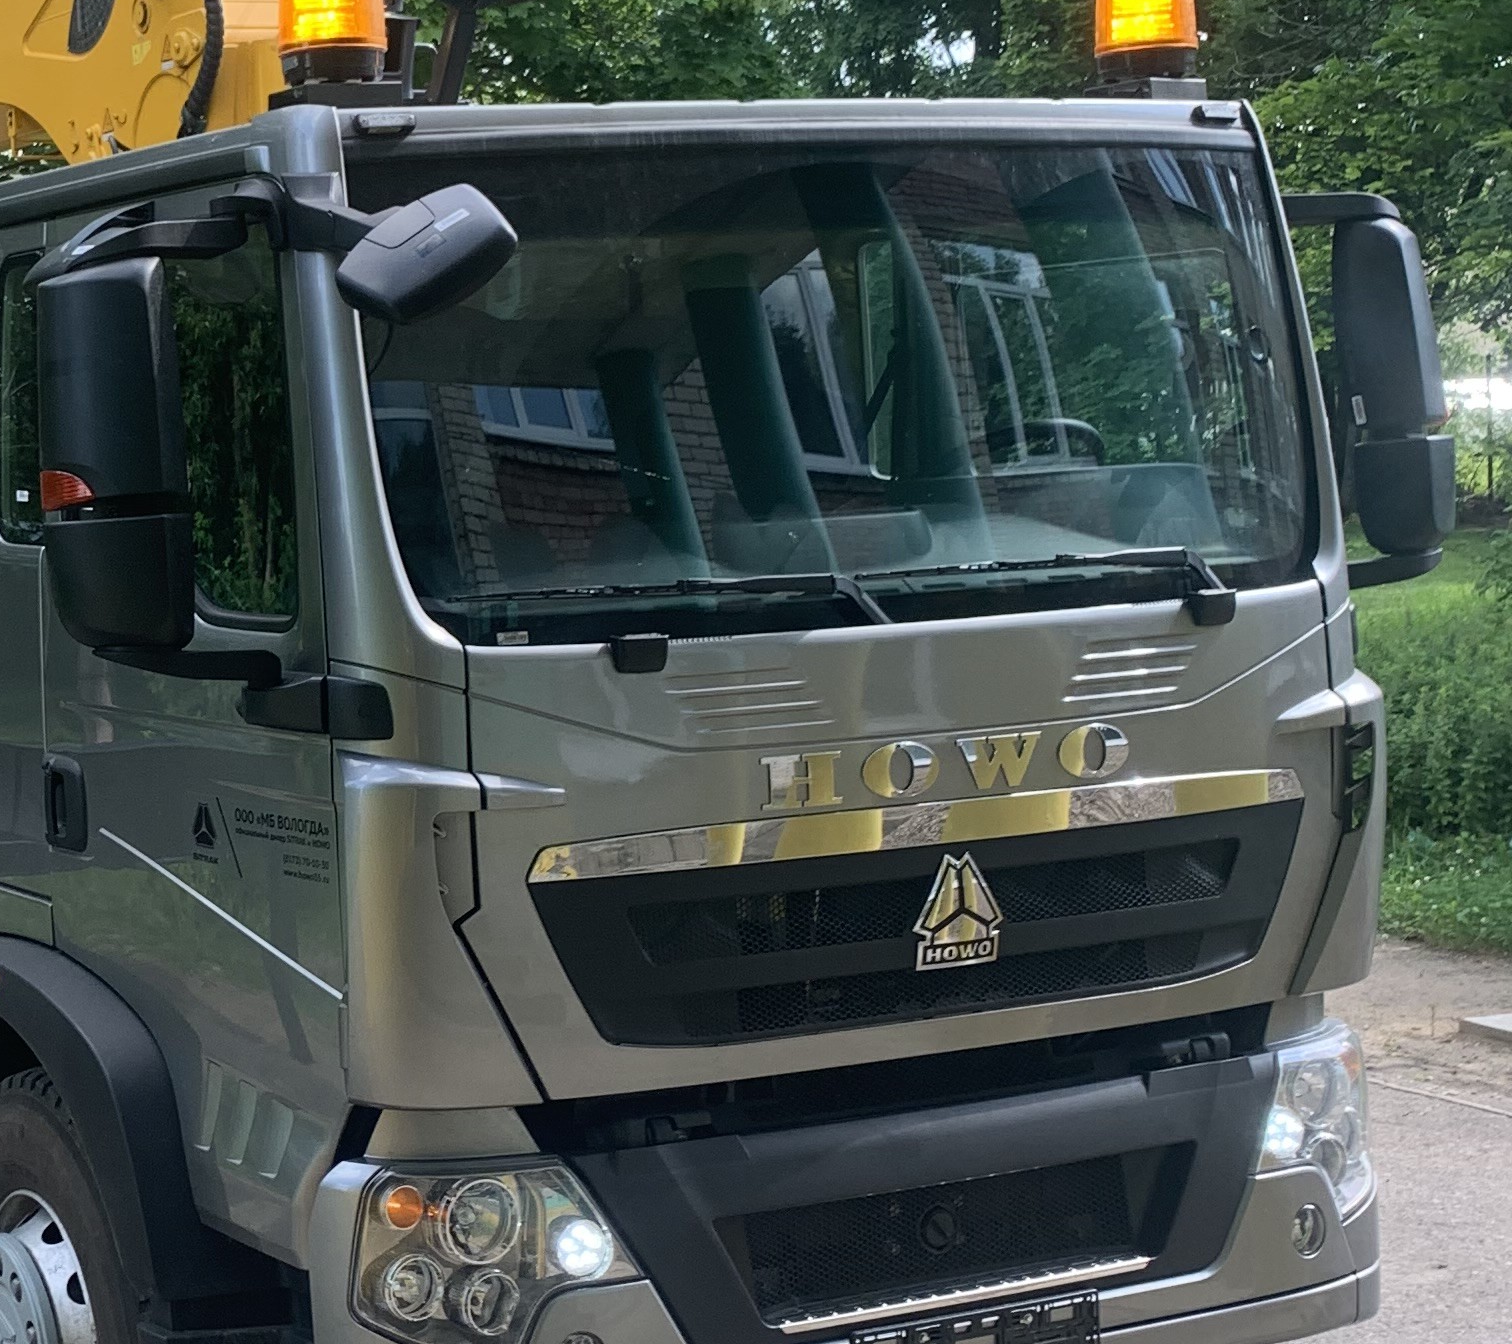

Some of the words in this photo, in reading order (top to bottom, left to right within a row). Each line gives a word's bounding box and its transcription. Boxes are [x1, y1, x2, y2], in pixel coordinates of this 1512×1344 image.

[759, 722, 1129, 811] HOWO
[234, 808, 254, 824] ООО
[256, 812, 275, 828] «МБ
[277, 815, 330, 836] ВОЛОГДА»
[925, 940, 992, 963] HOWO
